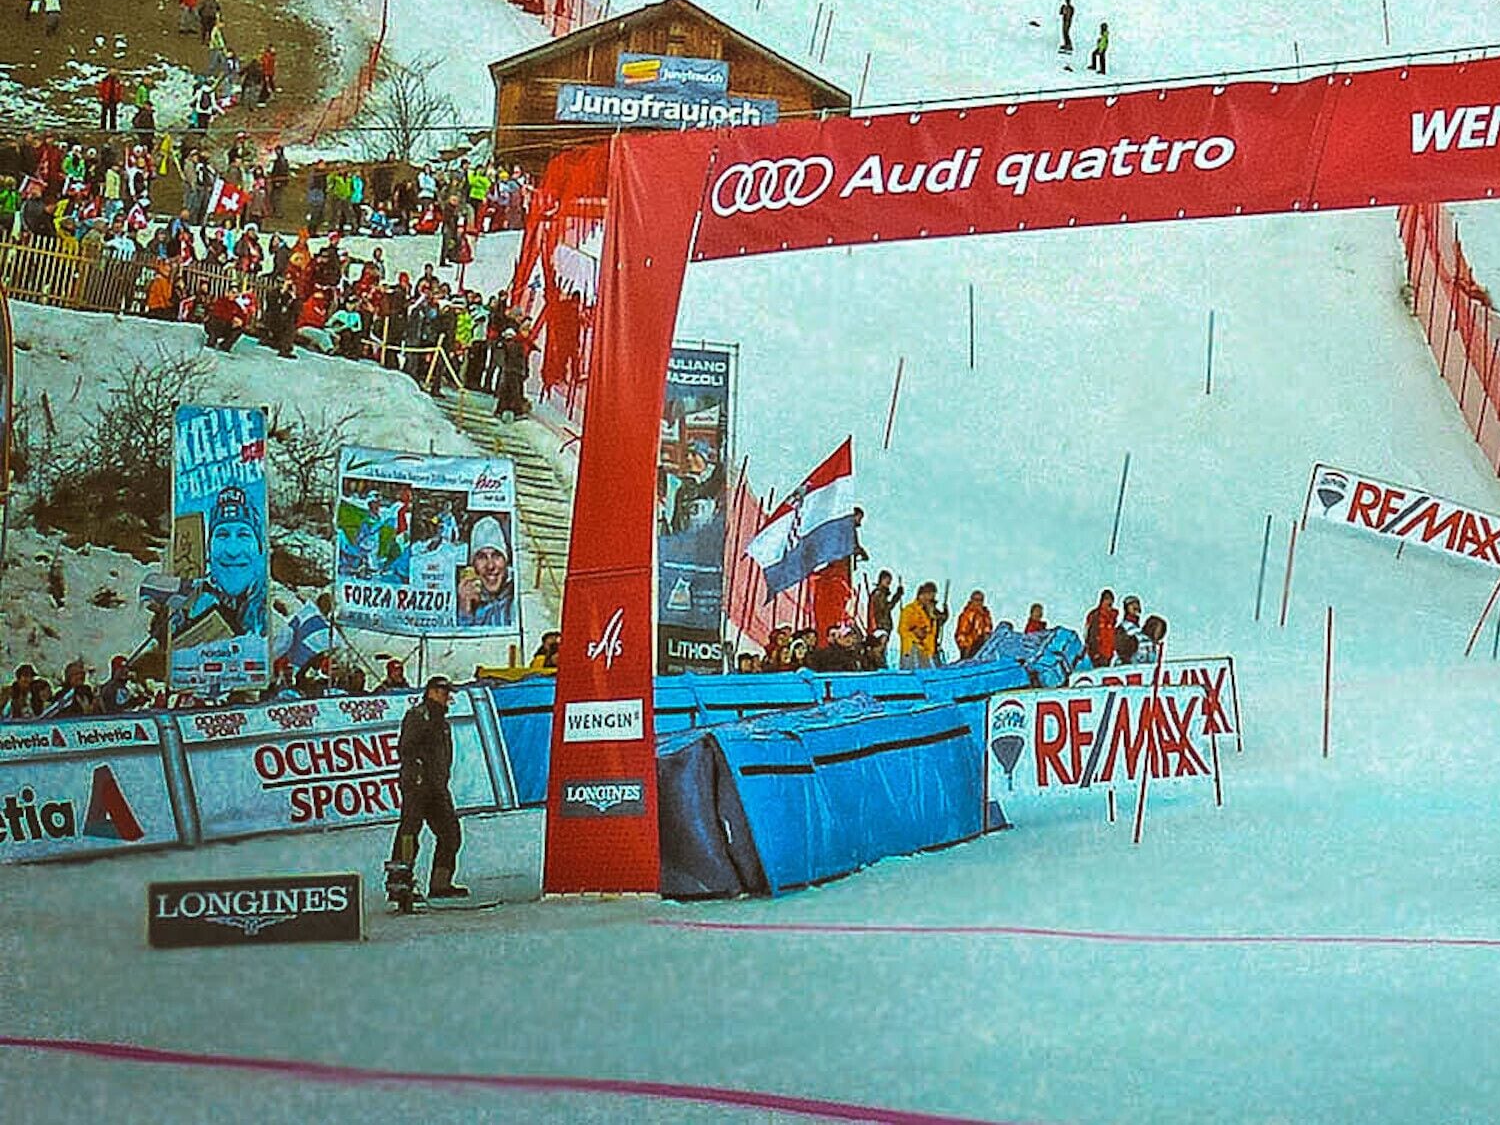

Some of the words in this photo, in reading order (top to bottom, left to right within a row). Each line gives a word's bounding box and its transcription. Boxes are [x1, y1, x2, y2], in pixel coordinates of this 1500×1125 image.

[569, 89, 762, 126] Jungfraujoch
[840, 147, 982, 198] Audi
[996, 134, 1236, 196] quattro
[344, 584, 392, 609] FORZA
[396, 589, 451, 612] RAZZO!
[667, 638, 722, 660] LITHOS
[76, 728, 132, 745] helvetia
[1034, 692, 1212, 788] RE/MAX
[255, 733, 401, 780] OCHSNE
[290, 777, 401, 822] SPORT
[566, 784, 641, 802] LONGINES
[156, 885, 349, 918] LONGINES
